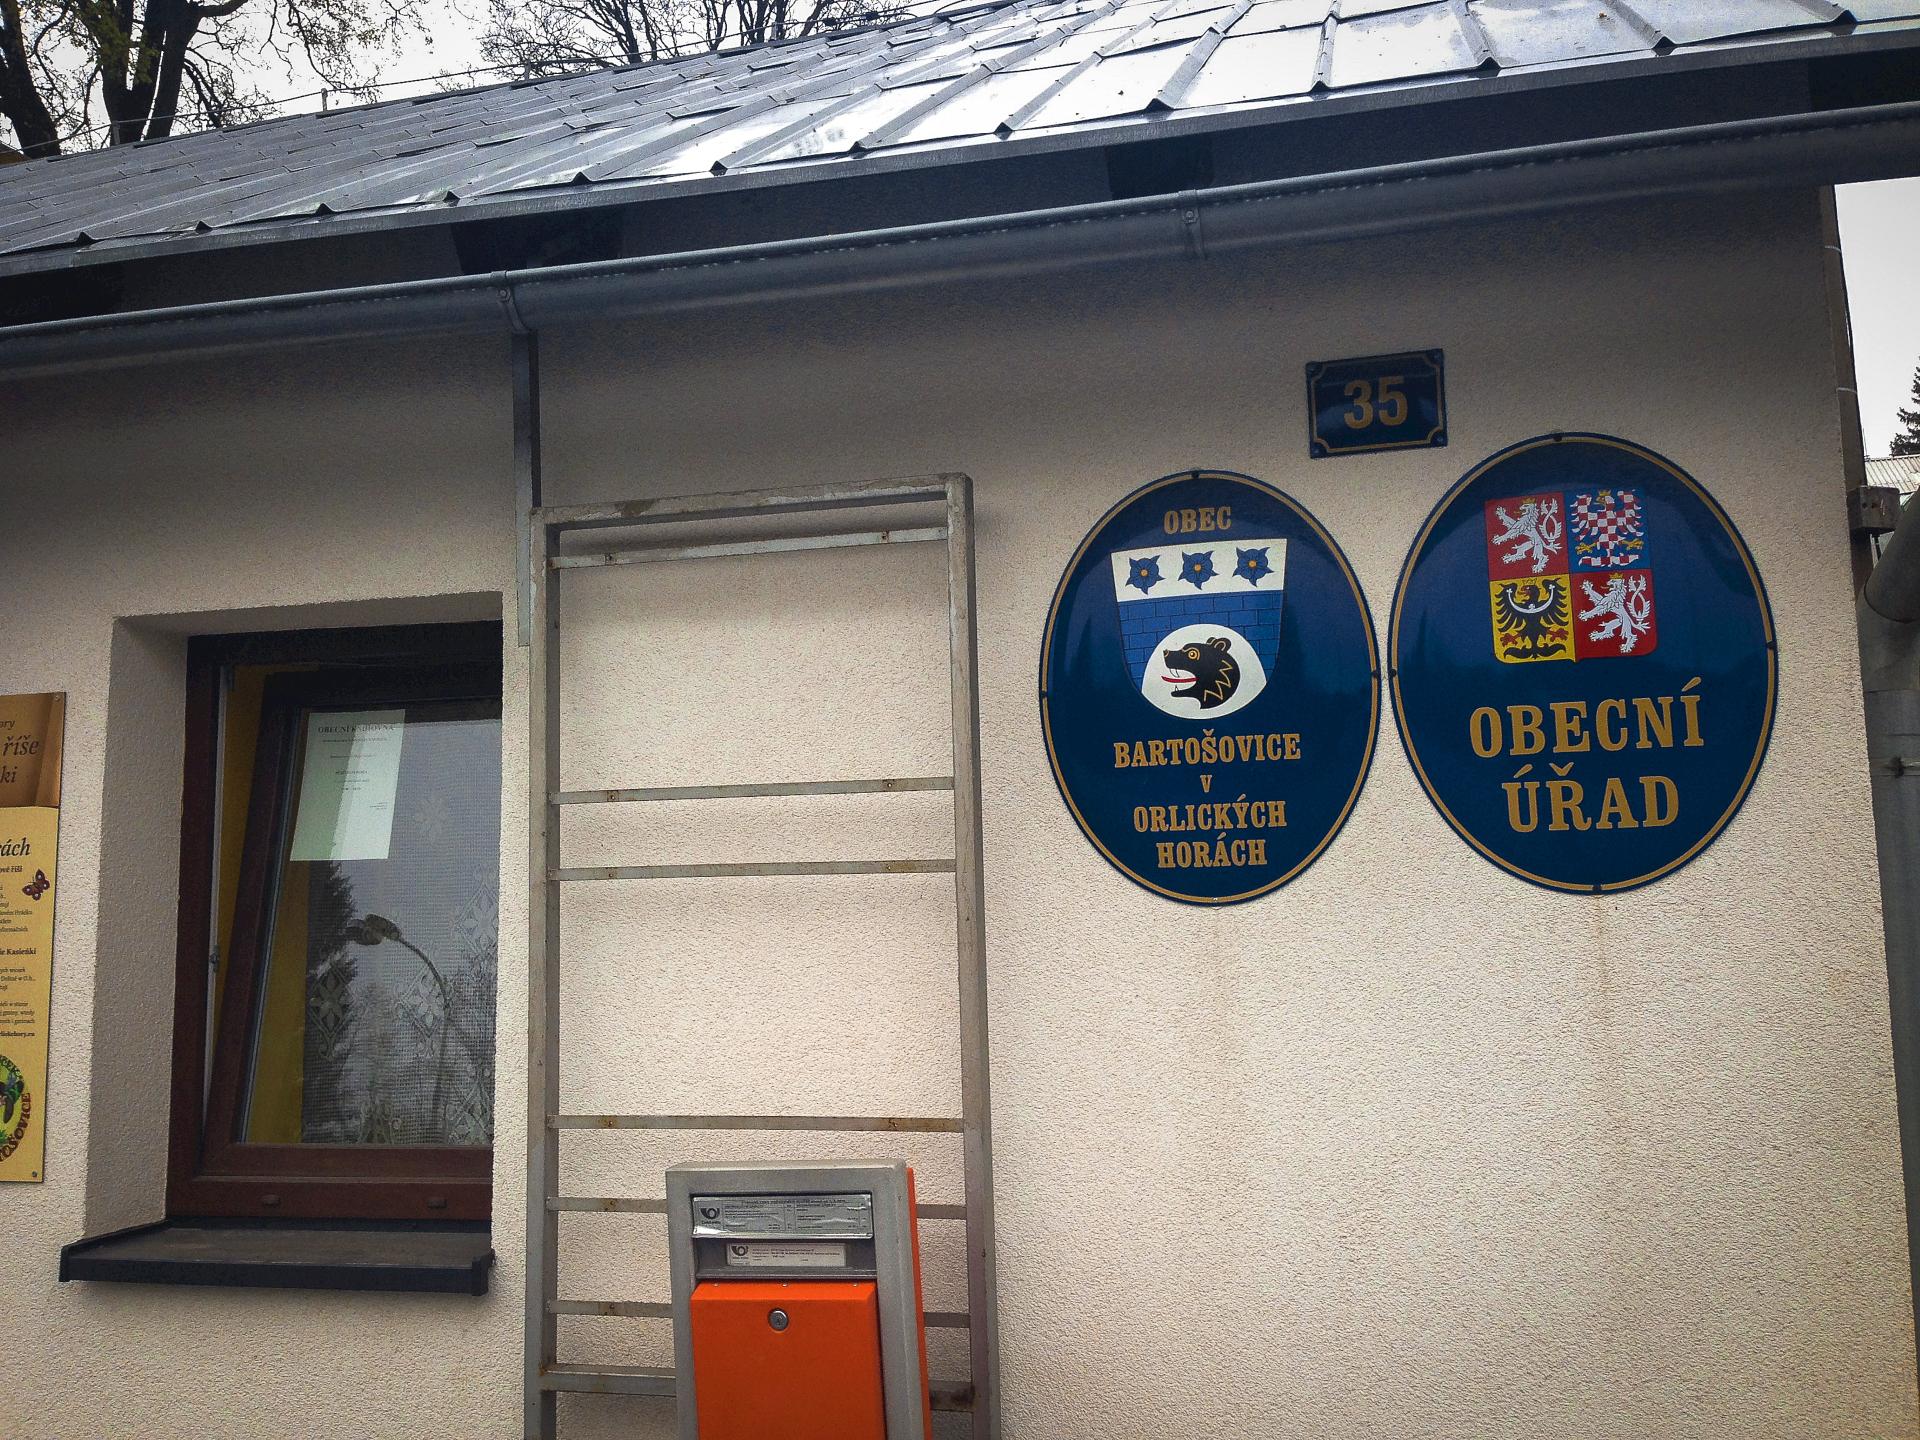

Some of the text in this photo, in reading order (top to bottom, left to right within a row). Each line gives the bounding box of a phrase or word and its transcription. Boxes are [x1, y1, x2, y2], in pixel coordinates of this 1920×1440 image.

[1344, 376, 1408, 429] 35
[1163, 506, 1232, 535] OBEC
[1469, 677, 1704, 758] OBECNÍ
[3, 734, 39, 757] říše
[1113, 728, 1301, 768] BARTOŠOVICE
[1200, 774, 1212, 793] V
[1502, 762, 1679, 833] ÚŘAD
[1133, 794, 1287, 833] ORLICKÝCH
[1156, 832, 1267, 869] HORÁCH
